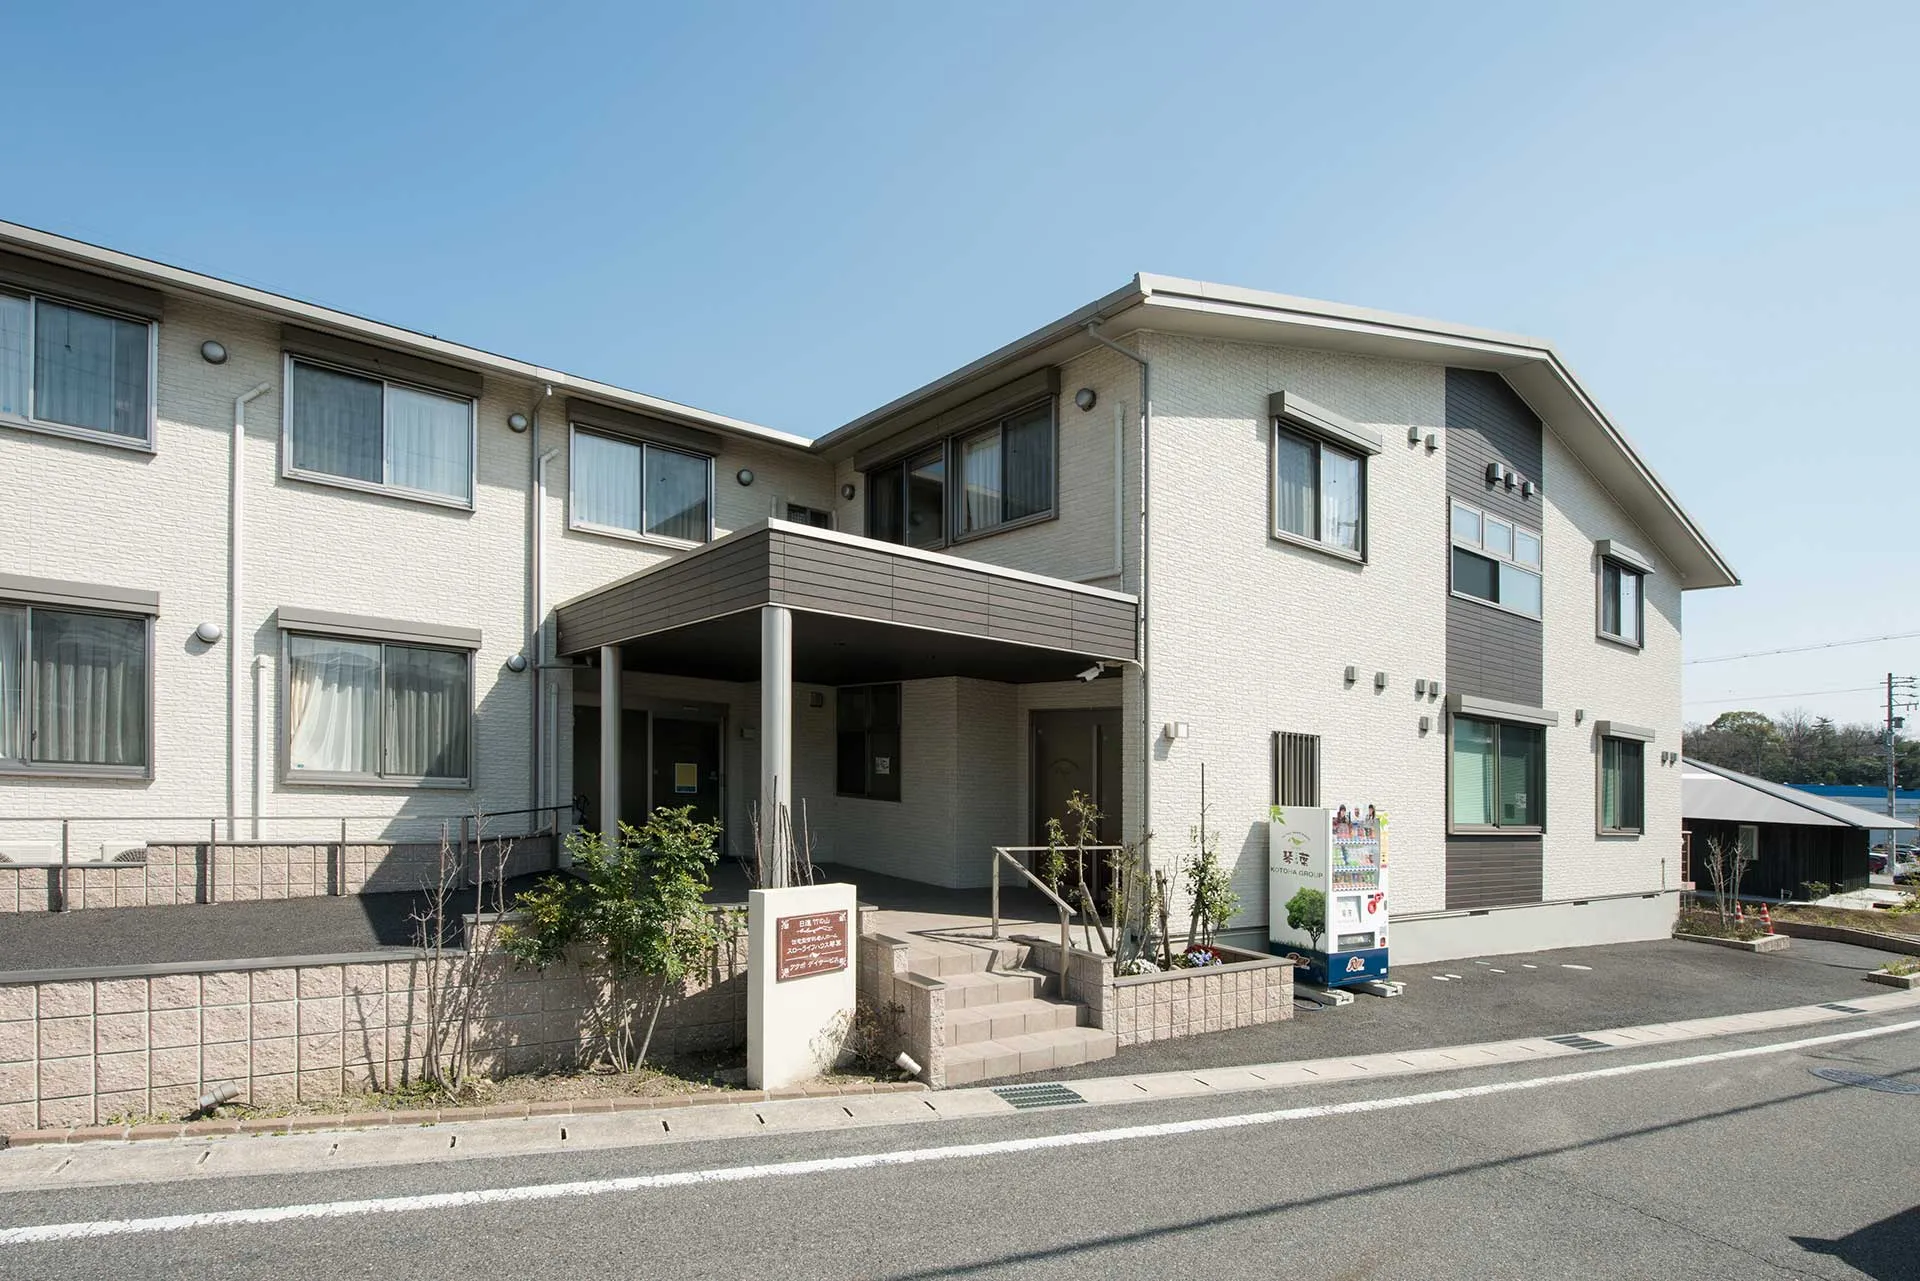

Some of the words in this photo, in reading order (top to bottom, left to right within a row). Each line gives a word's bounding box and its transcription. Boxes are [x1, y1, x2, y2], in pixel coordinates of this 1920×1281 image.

[1283, 850, 1310, 867] 琴葉
[1270, 866, 1297, 875] KOTOHA
[1298, 869, 1323, 878] GROUP
